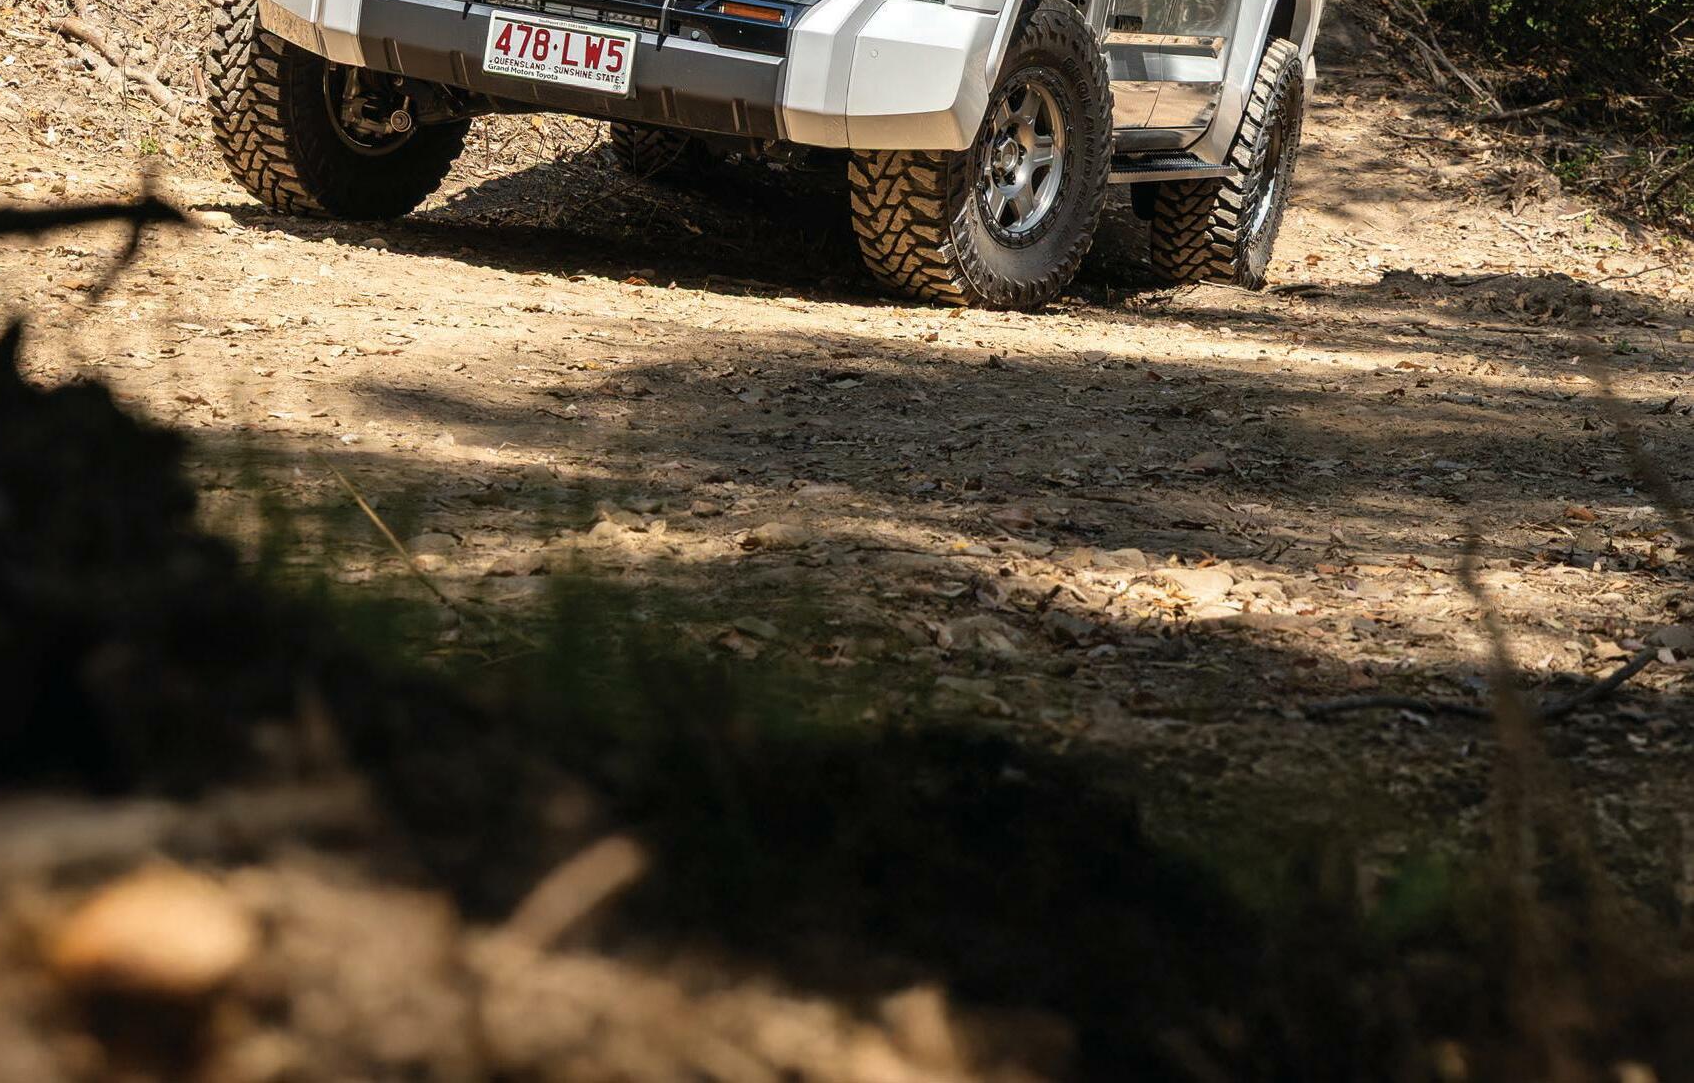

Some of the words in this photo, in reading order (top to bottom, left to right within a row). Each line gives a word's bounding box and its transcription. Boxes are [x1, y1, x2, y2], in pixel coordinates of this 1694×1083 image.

[487, 63, 510, 73] Grand
[510, 67, 535, 77] Motors
[536, 71, 558, 81] Toyota
[494, 56, 545, 71] QUEENSLAND
[553, 65, 593, 79] SUNSHINE
[596, 72, 621, 84] STATE
